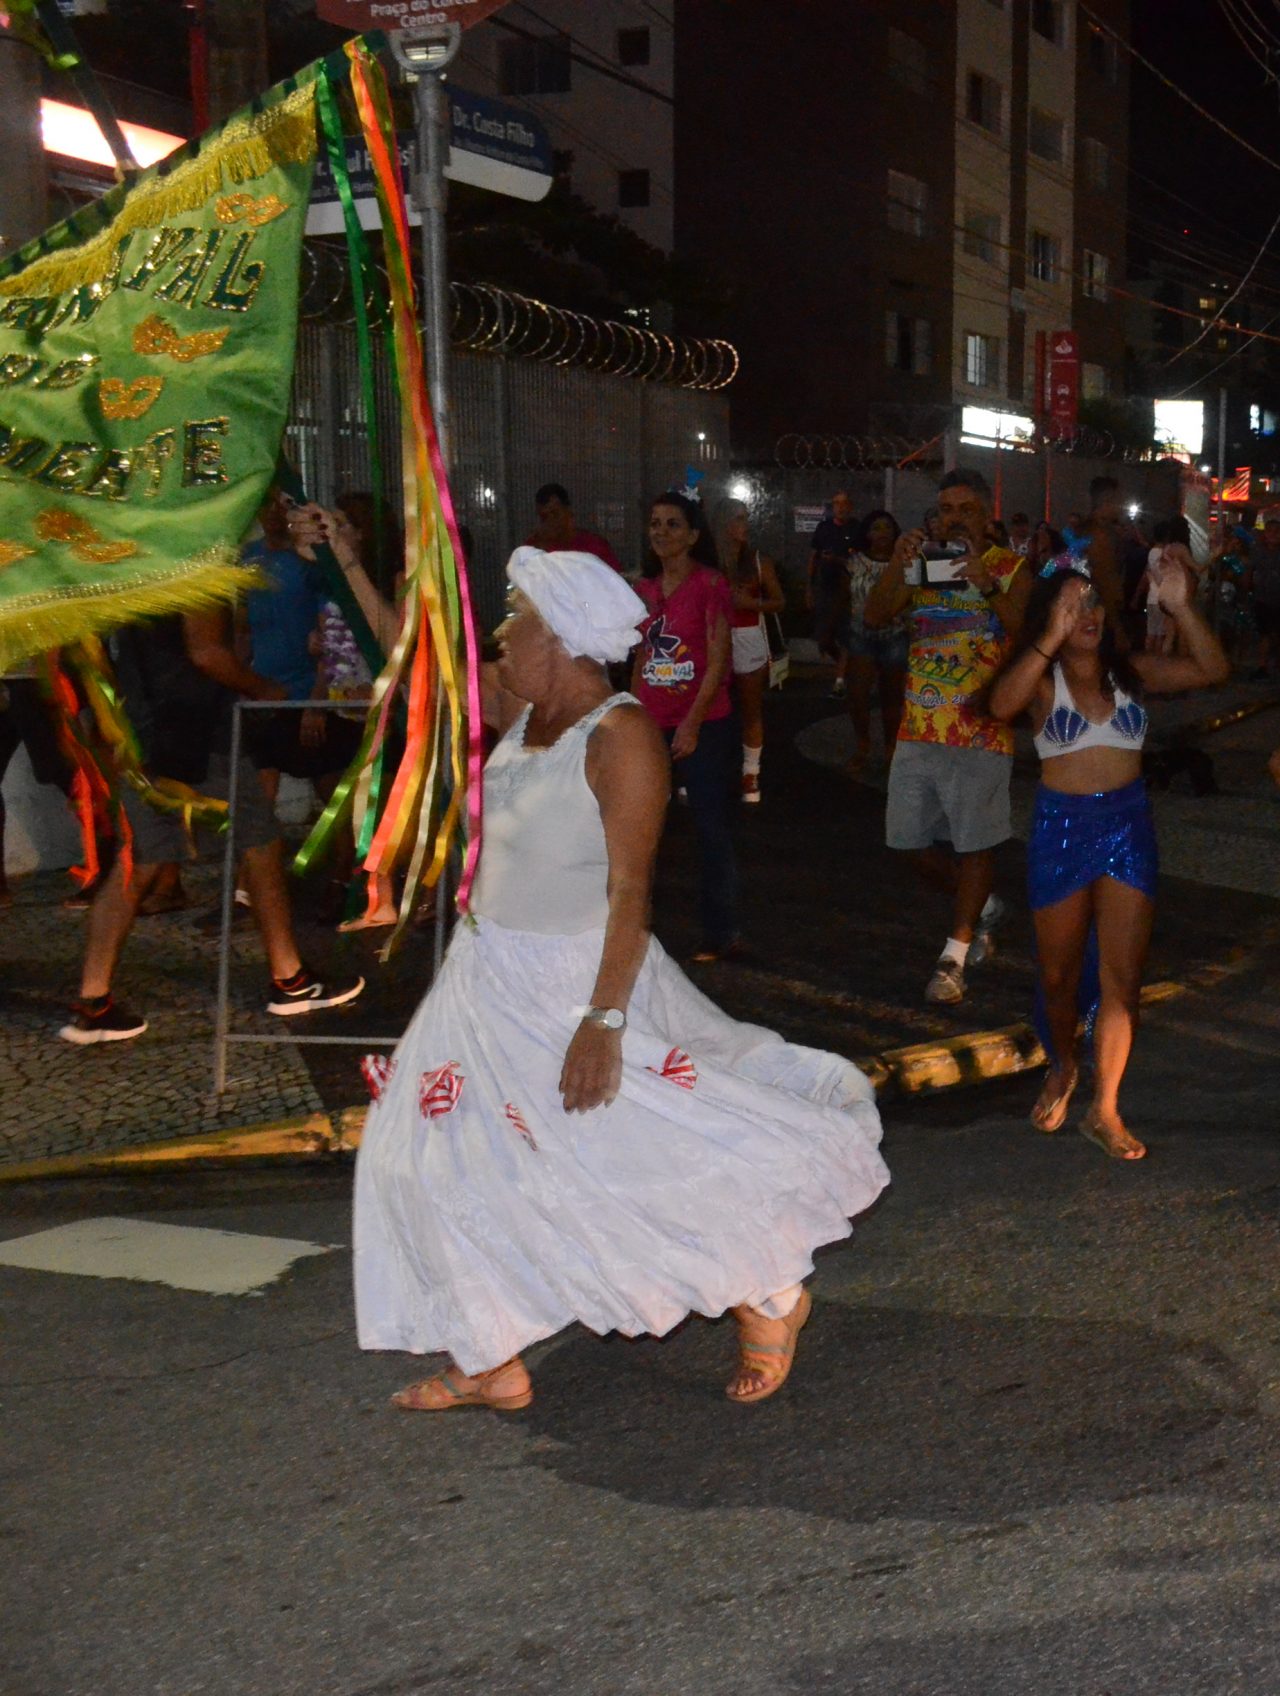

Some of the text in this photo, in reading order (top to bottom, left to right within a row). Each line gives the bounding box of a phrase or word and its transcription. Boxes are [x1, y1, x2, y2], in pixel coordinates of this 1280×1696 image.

[370, 3, 408, 17] Praça
[410, 0, 430, 11] do
[400, 12, 447, 28] Centro
[453, 105, 535, 148] Dr. Costa Filho
